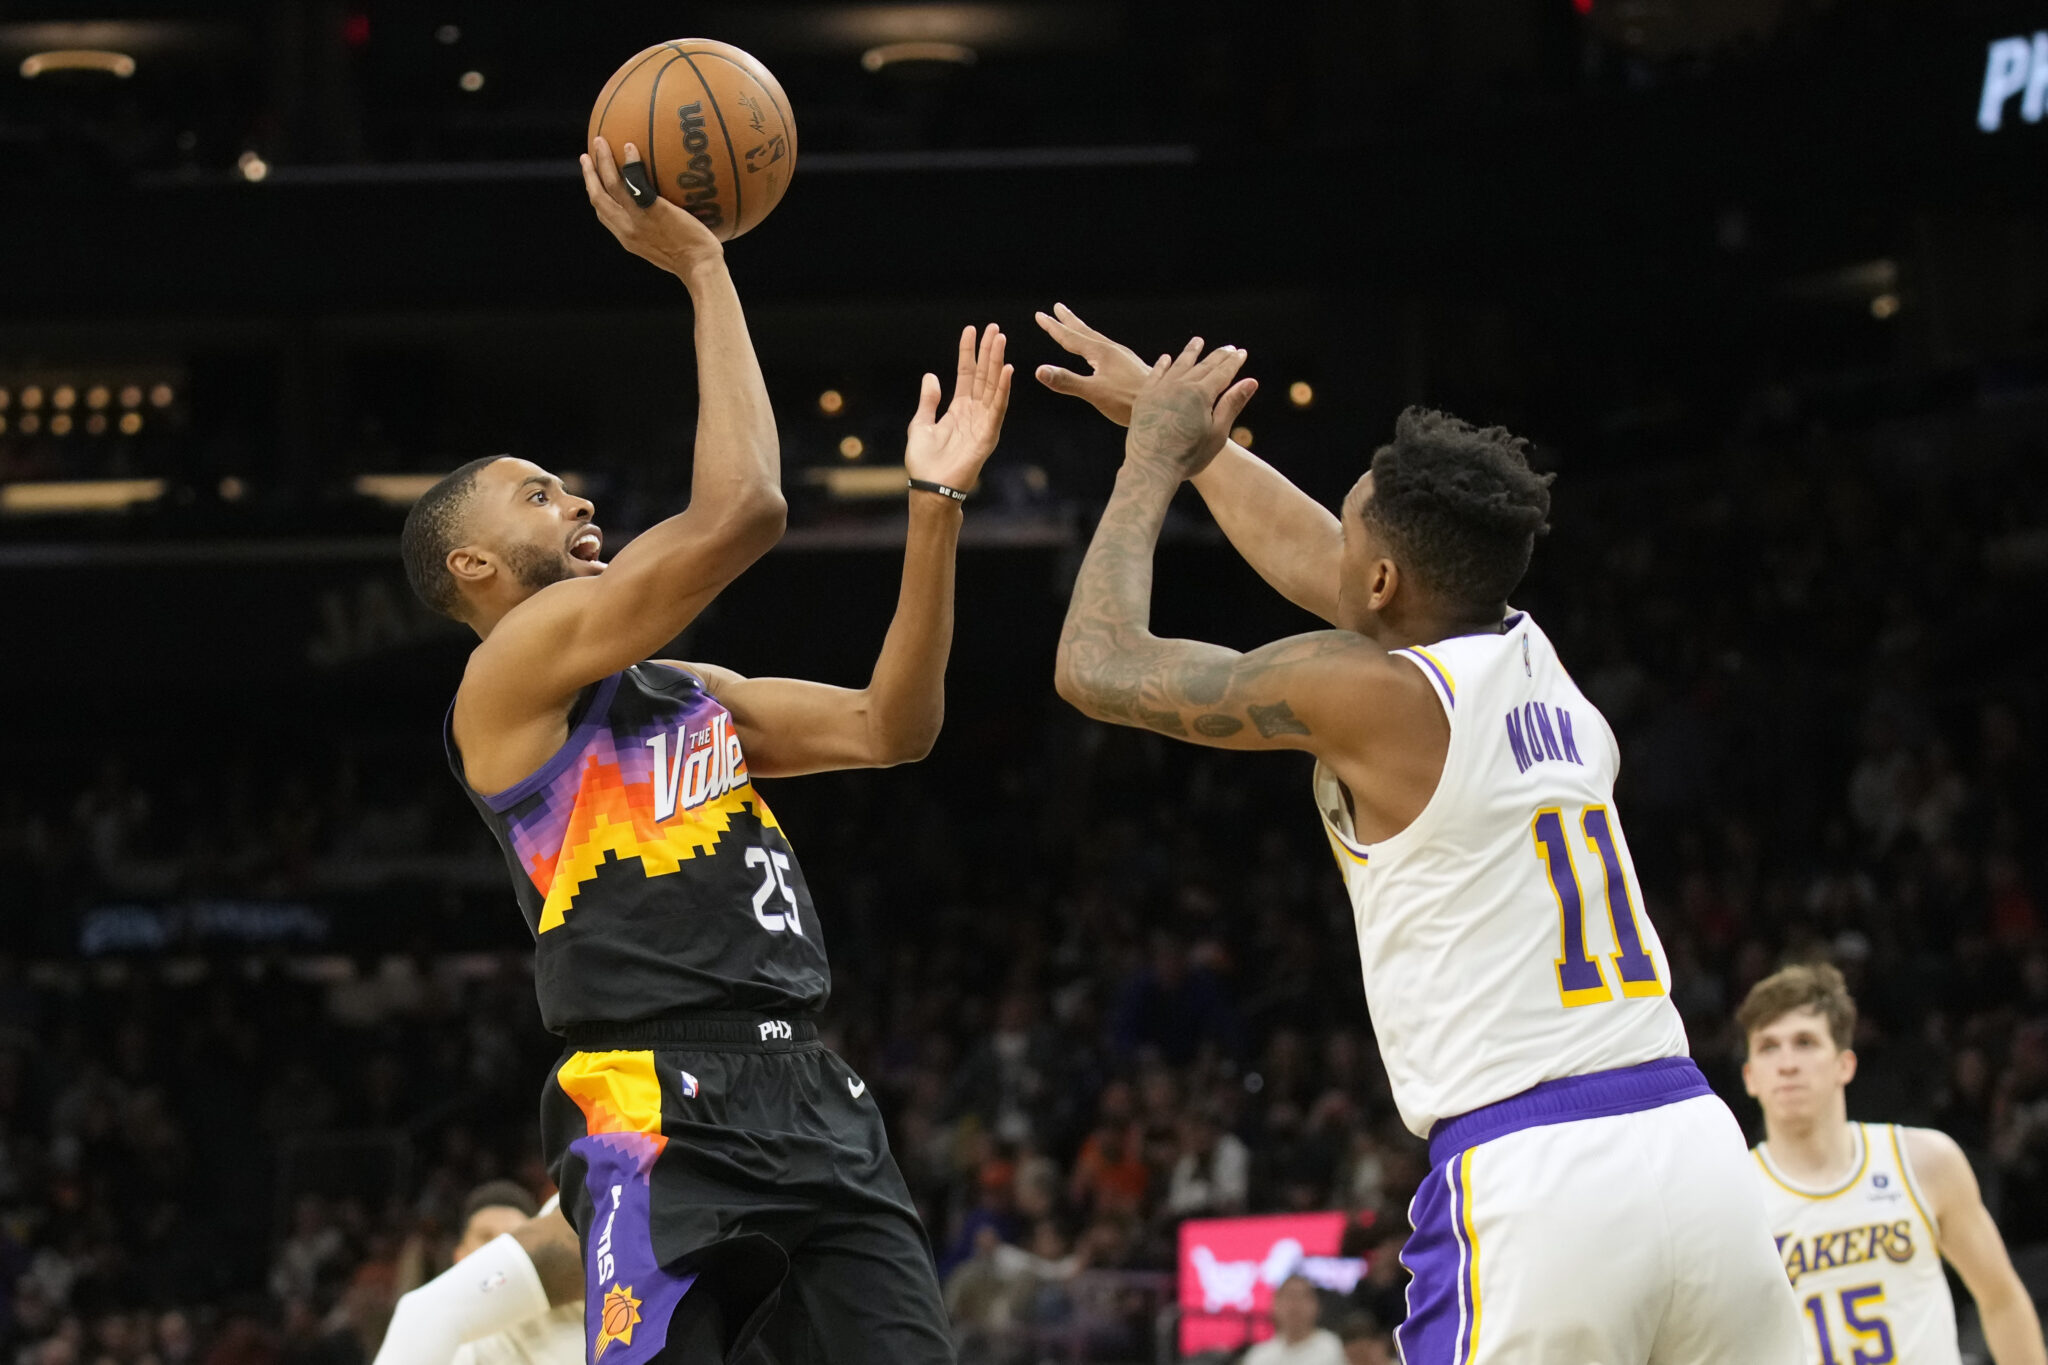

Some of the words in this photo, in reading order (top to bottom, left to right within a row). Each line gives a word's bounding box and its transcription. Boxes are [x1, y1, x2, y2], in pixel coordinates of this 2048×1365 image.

[689, 727, 711, 750] THE
[1506, 701, 1584, 774] MONK
[744, 845, 803, 936] 25
[1531, 803, 1666, 1008] 11
[1804, 1282, 1898, 1365] 15
